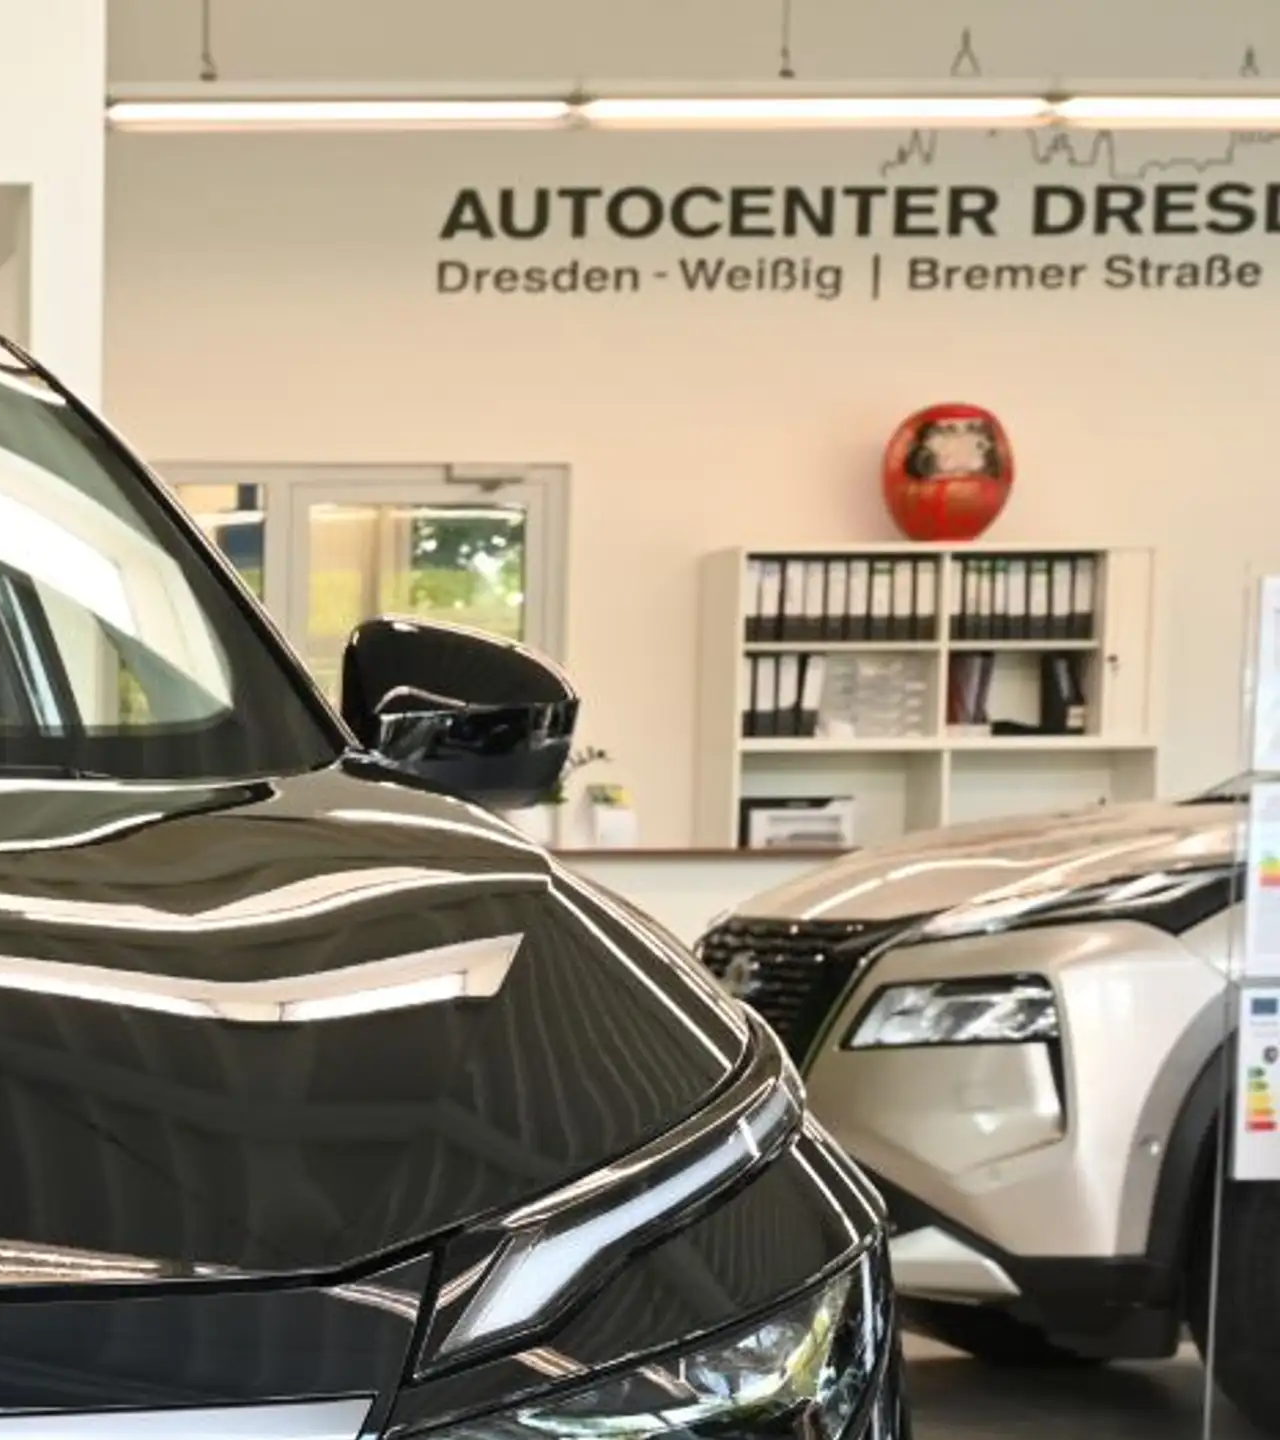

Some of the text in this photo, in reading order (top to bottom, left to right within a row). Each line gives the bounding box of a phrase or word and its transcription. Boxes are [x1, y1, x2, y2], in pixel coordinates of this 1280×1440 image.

[439, 182, 1280, 239] AUTOCENTER DRES
[437, 259, 639, 294] Dresden
[679, 256, 842, 300] Weißig
[908, 256, 1088, 290] Bremer
[1104, 252, 1263, 289] Straße
